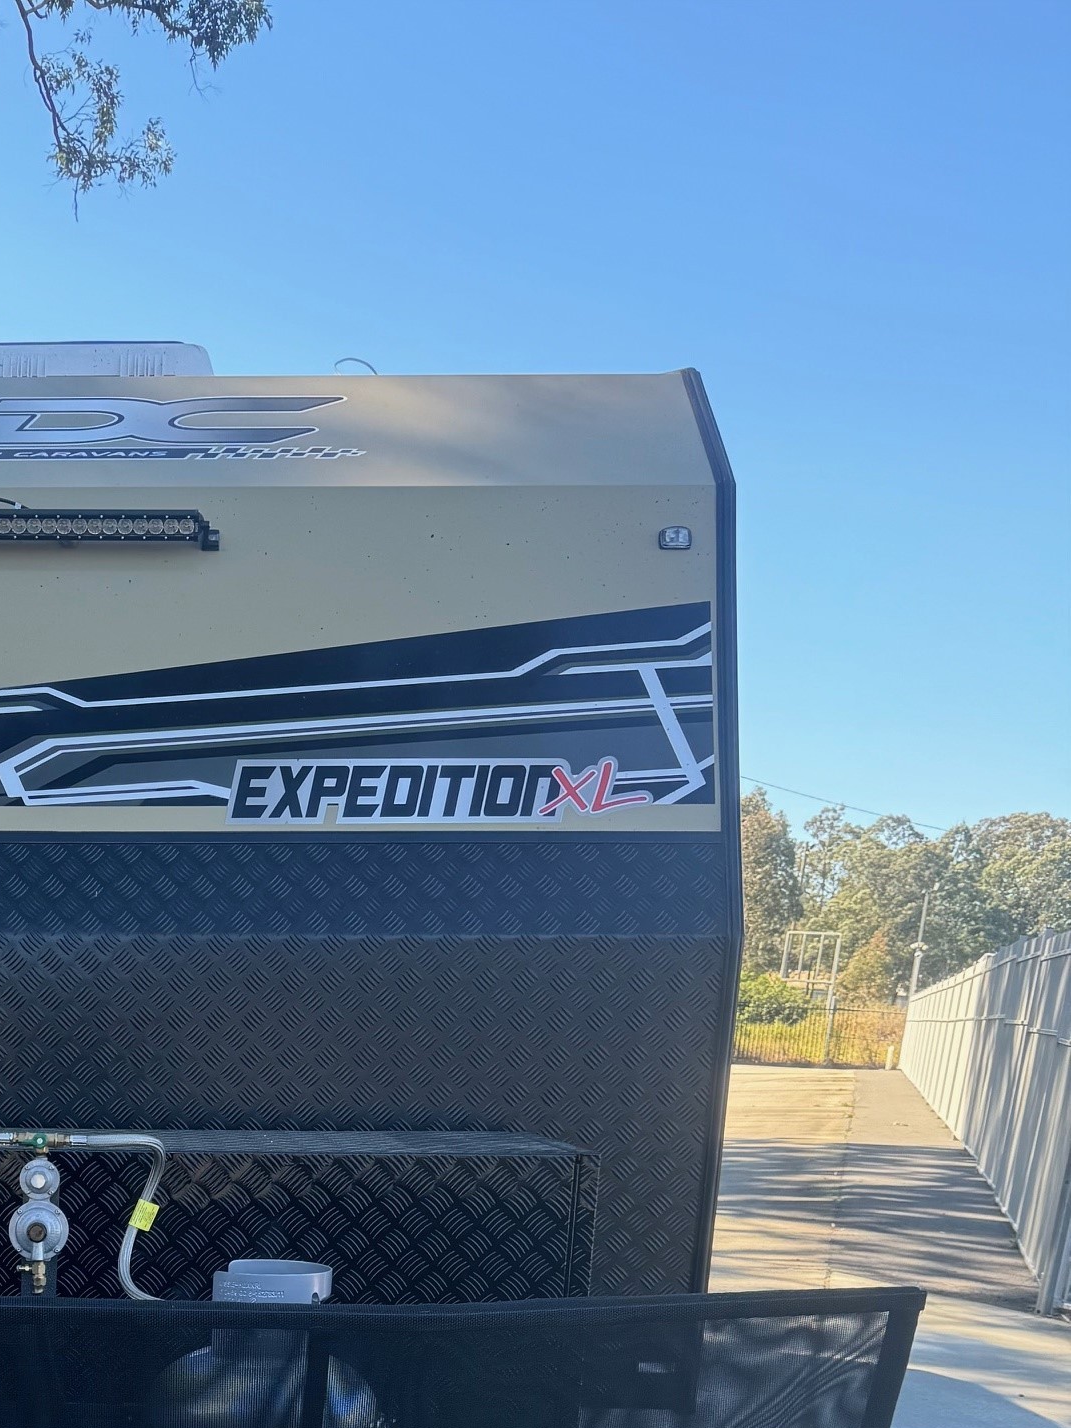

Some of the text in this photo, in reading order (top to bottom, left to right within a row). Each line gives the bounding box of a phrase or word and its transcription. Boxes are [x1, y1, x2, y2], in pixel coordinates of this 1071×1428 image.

[12, 450, 169, 458] CARAVANS
[229, 760, 649, 819] EXPEDITION XL
